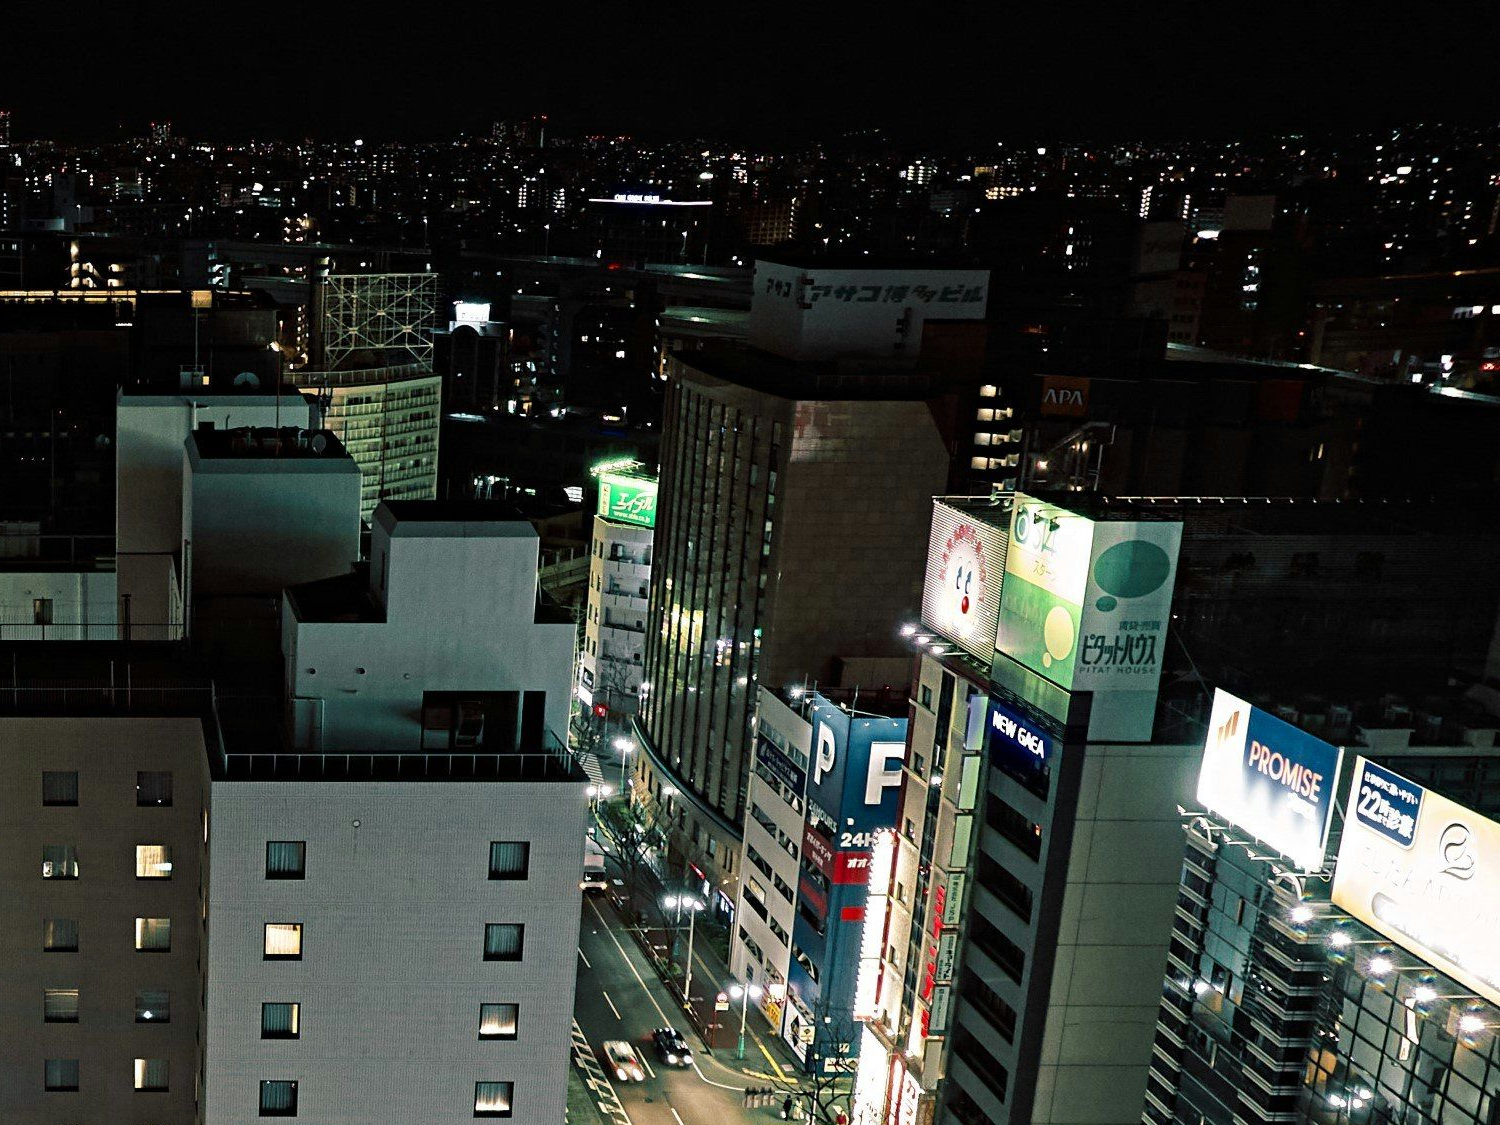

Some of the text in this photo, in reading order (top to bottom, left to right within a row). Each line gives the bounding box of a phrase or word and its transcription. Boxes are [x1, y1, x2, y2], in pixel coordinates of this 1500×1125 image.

[1044, 388, 1083, 406] APA
[1081, 634, 1157, 666] ピタットハウス
[1079, 666, 1156, 675] PITAT HOUSE
[813, 720, 836, 786] P
[992, 710, 1045, 759] NEW GAEA
[1248, 740, 1324, 803] PROMISE
